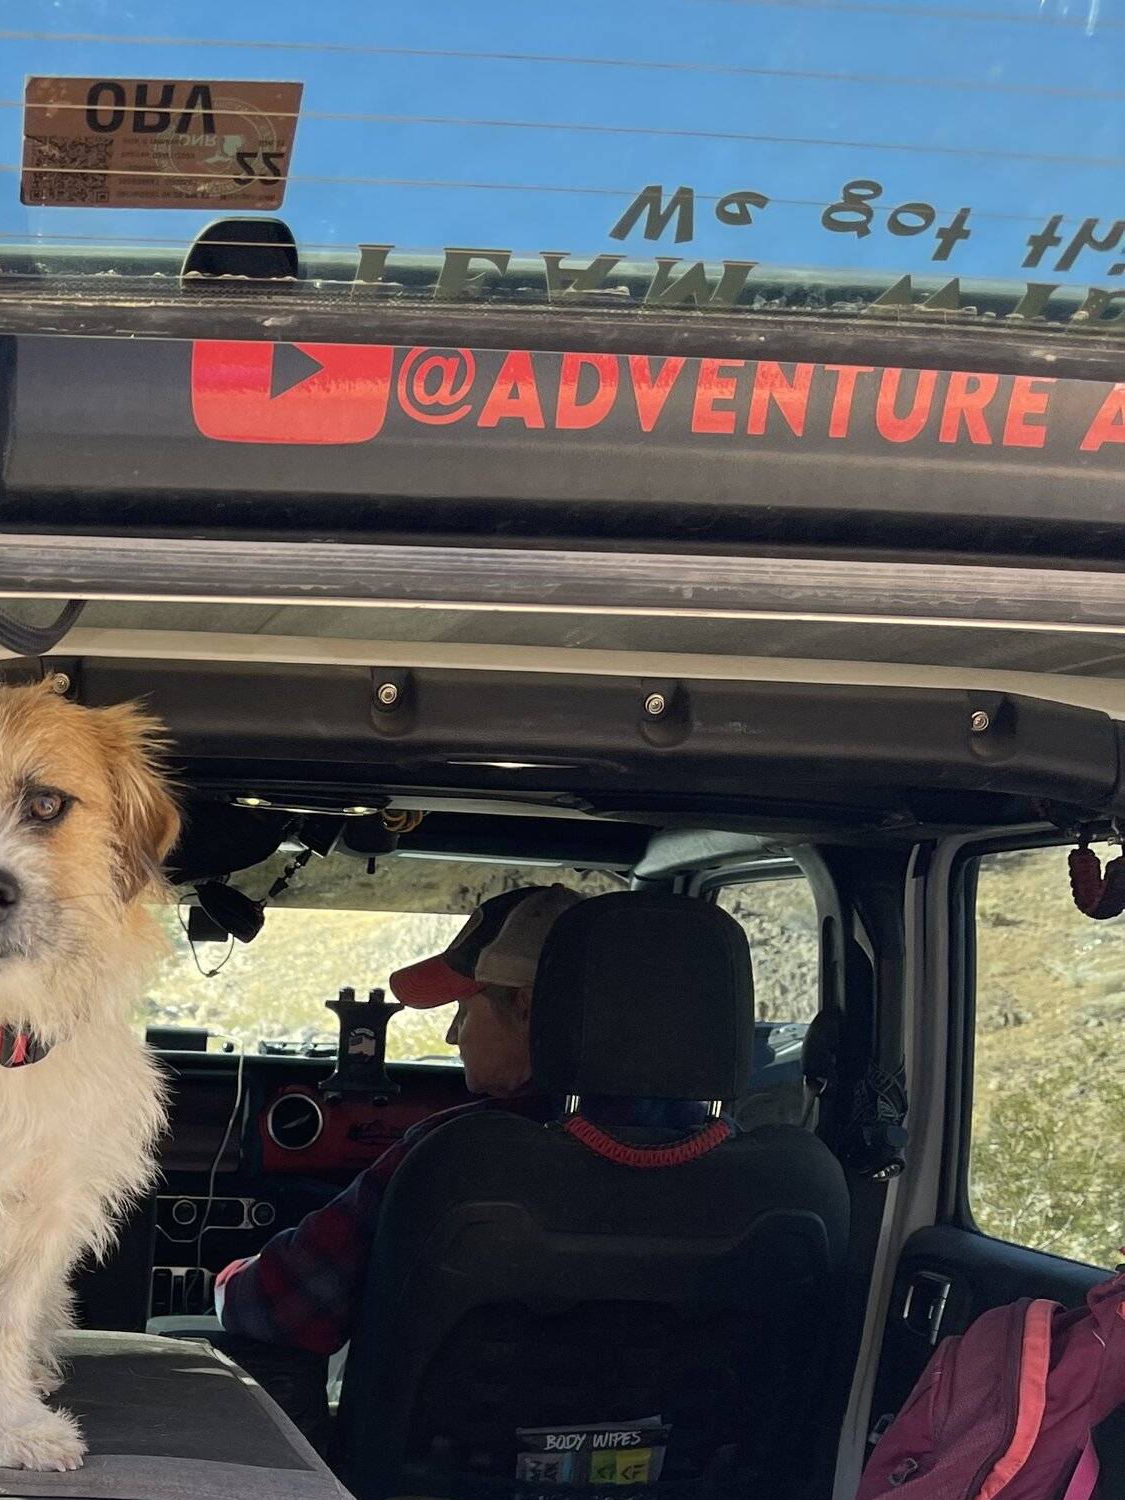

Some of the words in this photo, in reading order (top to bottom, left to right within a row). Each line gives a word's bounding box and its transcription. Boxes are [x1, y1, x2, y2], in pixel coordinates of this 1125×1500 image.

[397, 347, 1057, 448] @ADVENTURE
[543, 1433, 587, 1450] BODY
[593, 1431, 642, 1447] WIPES
